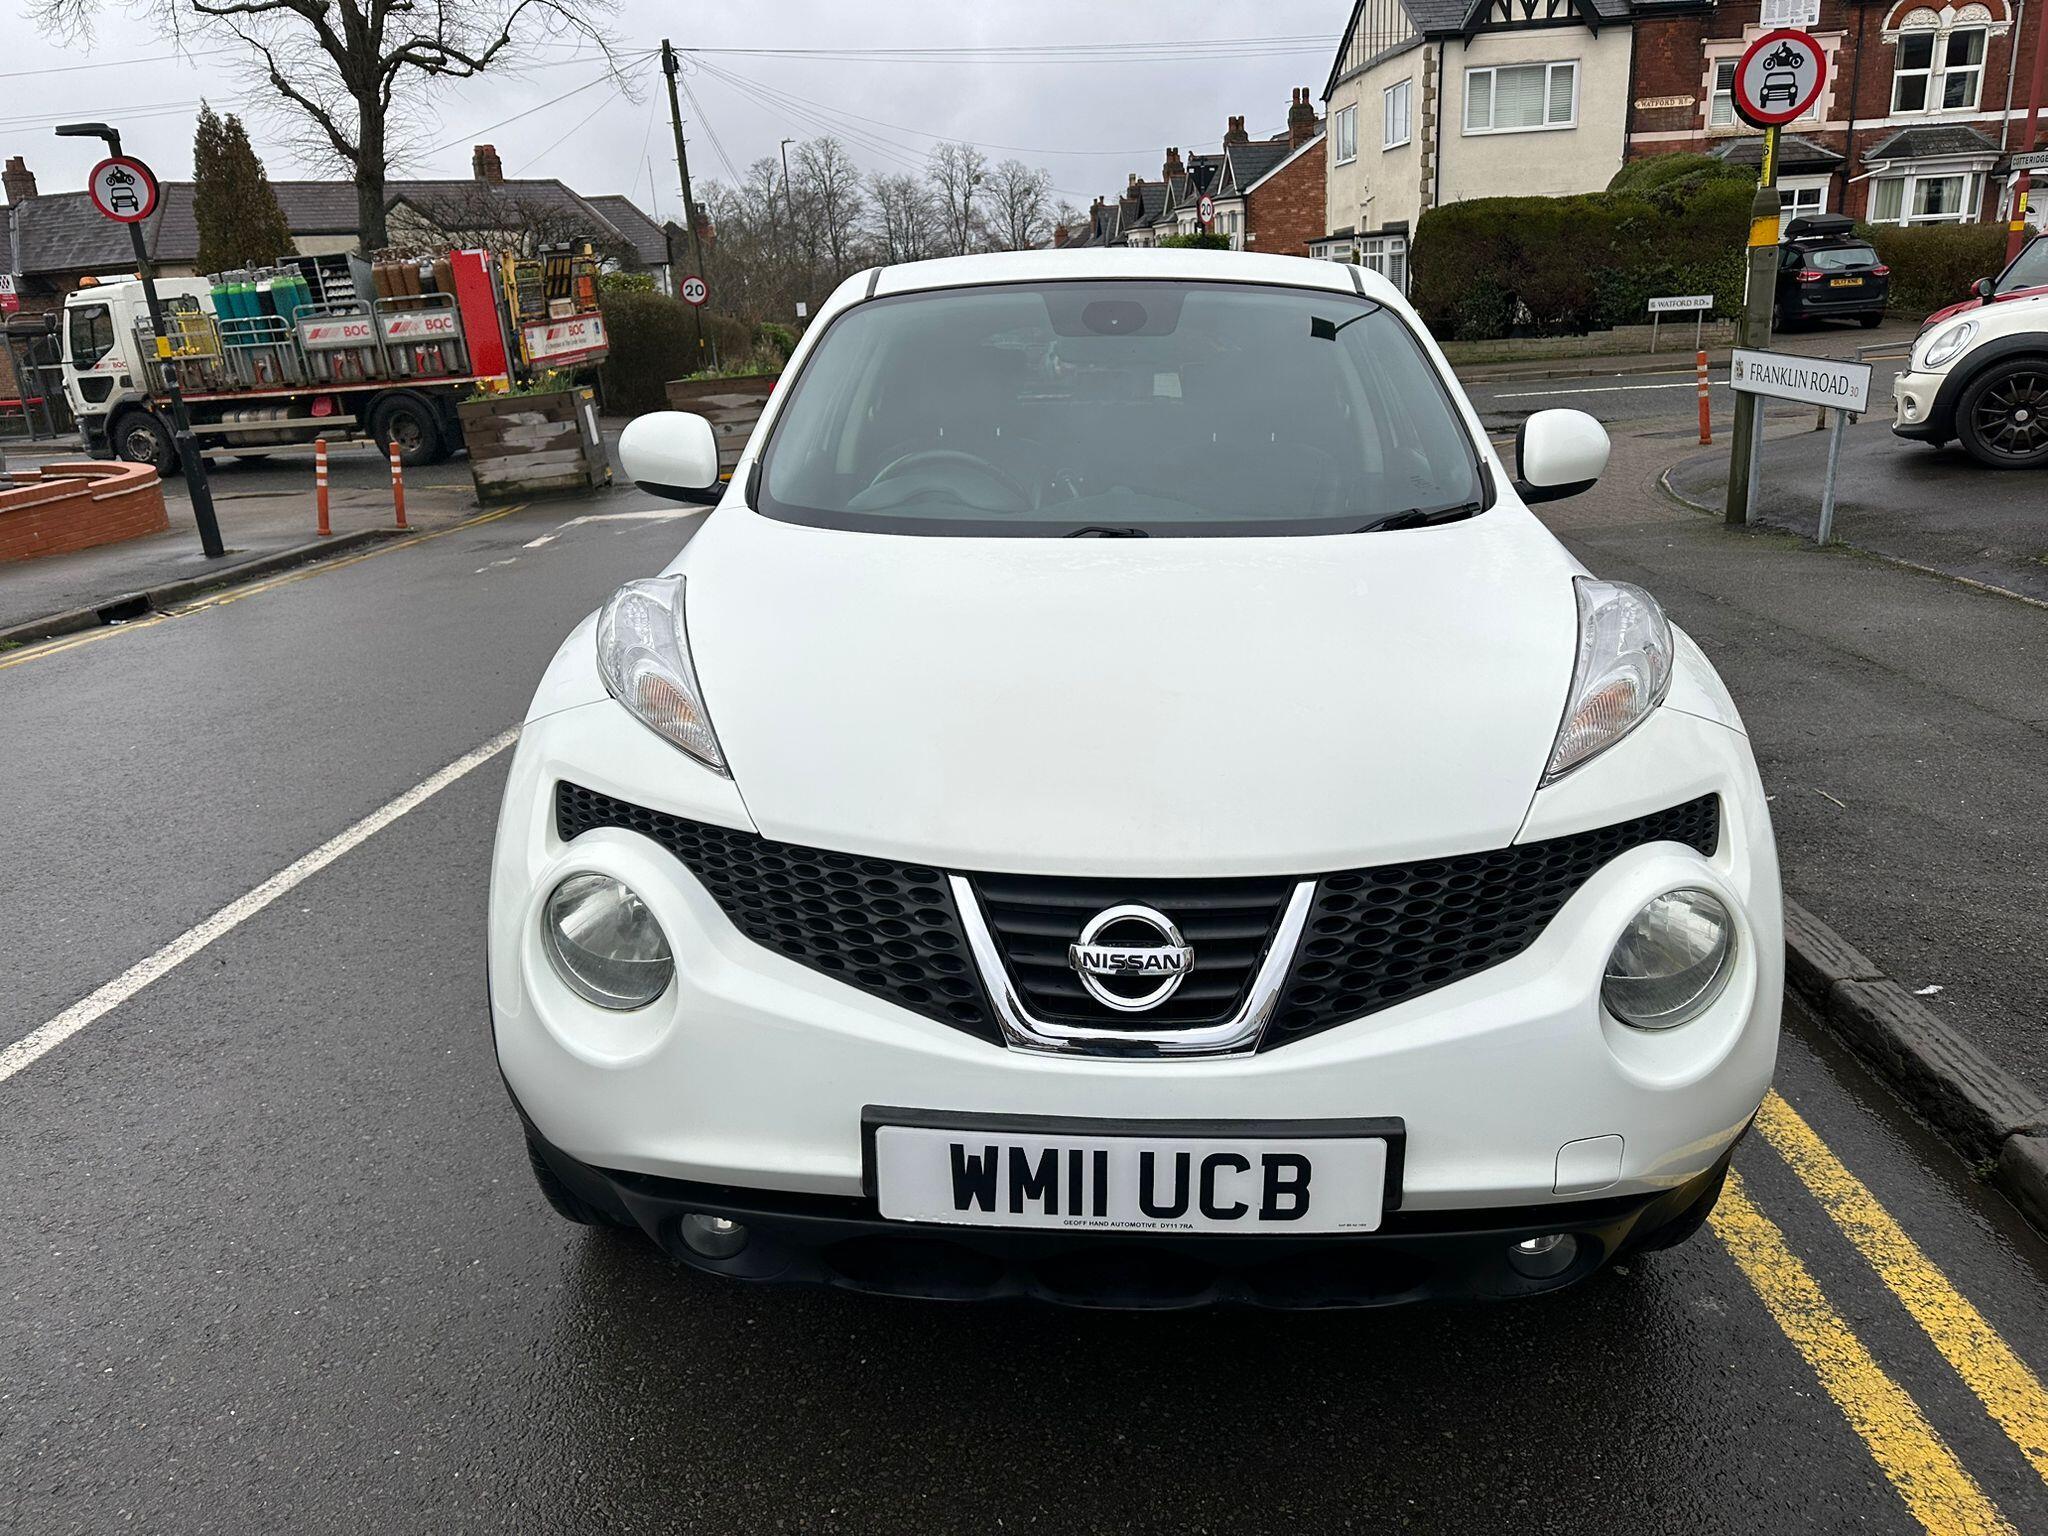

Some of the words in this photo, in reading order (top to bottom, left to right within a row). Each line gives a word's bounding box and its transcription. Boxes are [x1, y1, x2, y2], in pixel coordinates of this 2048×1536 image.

[1641, 99, 1675, 107] WATFORD
[1201, 203, 1212, 216] 20
[685, 284, 704, 297] 20
[1657, 299, 1693, 308] WATFORD
[343, 324, 370, 337] BOC
[424, 317, 453, 331] BOC
[568, 322, 585, 337] BOC
[1750, 363, 1809, 391] FRANKLIN
[1810, 371, 1849, 396] ROAD
[1850, 385, 1860, 398] 30
[1083, 951, 1181, 970] NISSAN
[949, 1143, 1109, 1218] WM11
[1138, 1151, 1313, 1222] UCB
[1110, 1220, 1157, 1229] AUTOMOTIVE
